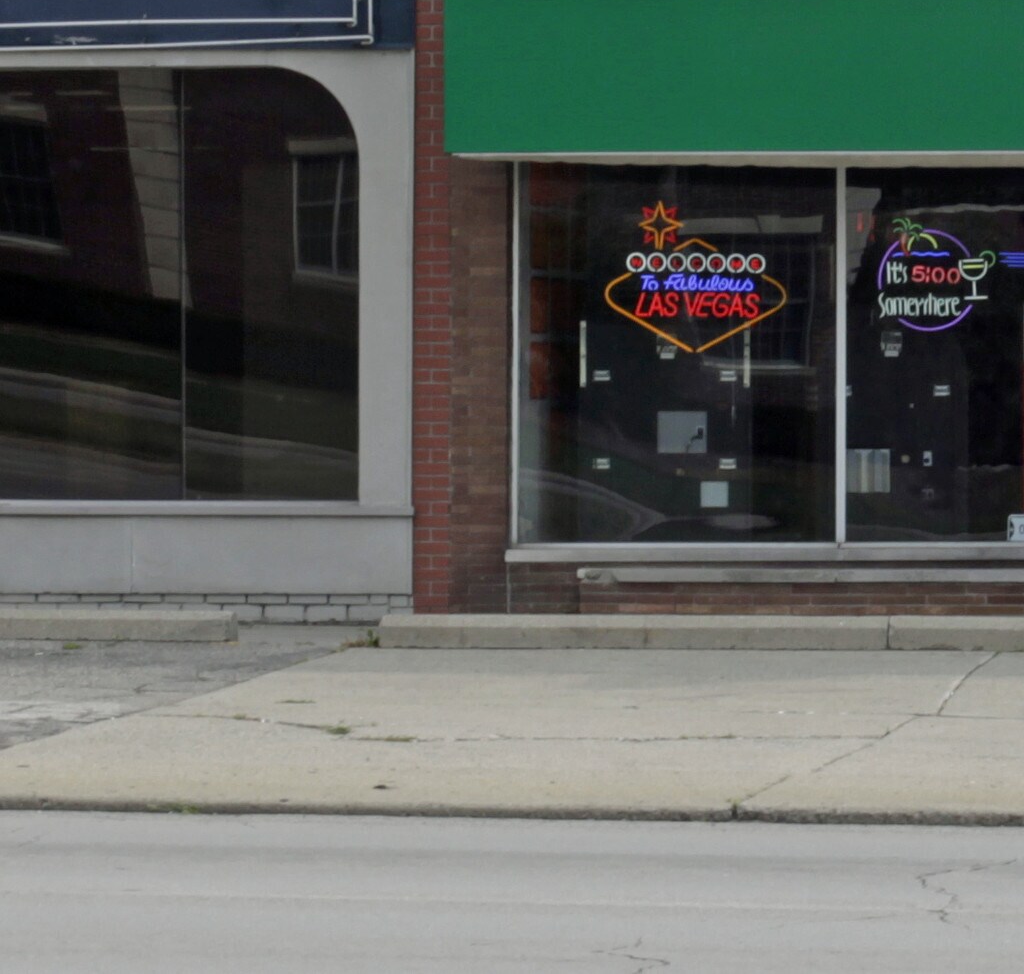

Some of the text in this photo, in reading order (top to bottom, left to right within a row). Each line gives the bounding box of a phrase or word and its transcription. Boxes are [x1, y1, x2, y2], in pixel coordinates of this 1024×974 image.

[640, 273, 755, 292] To Fabulous
[885, 260, 962, 285] It's 5:00
[634, 292, 762, 319] LAS VEGAS
[877, 292, 962, 319] Somewhere
